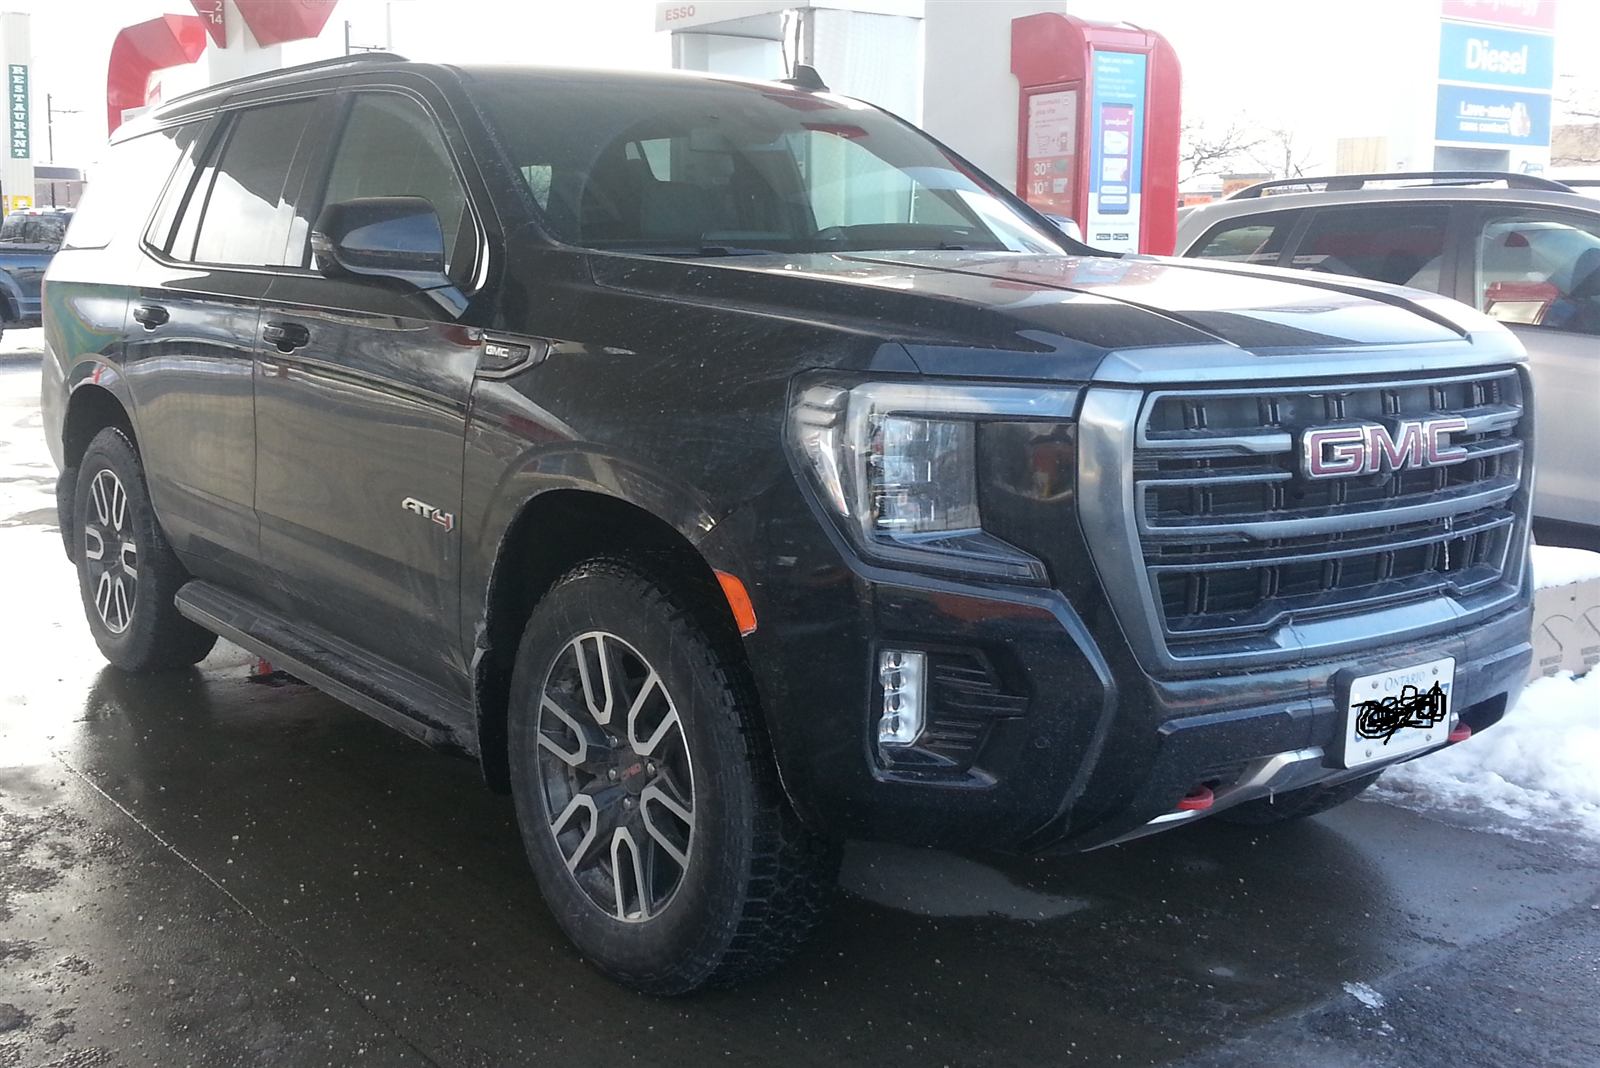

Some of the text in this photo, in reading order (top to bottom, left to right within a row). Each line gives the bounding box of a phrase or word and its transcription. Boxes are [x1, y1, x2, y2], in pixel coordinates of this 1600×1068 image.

[209, 14, 223, 24] 14
[215, 1, 223, 11] 2
[665, 5, 695, 21] ESSO
[1466, 38, 1528, 74] Diesel
[12, 66, 26, 157] RESTAURANT
[1303, 418, 1468, 478] GMC
[402, 497, 453, 533] AT4
